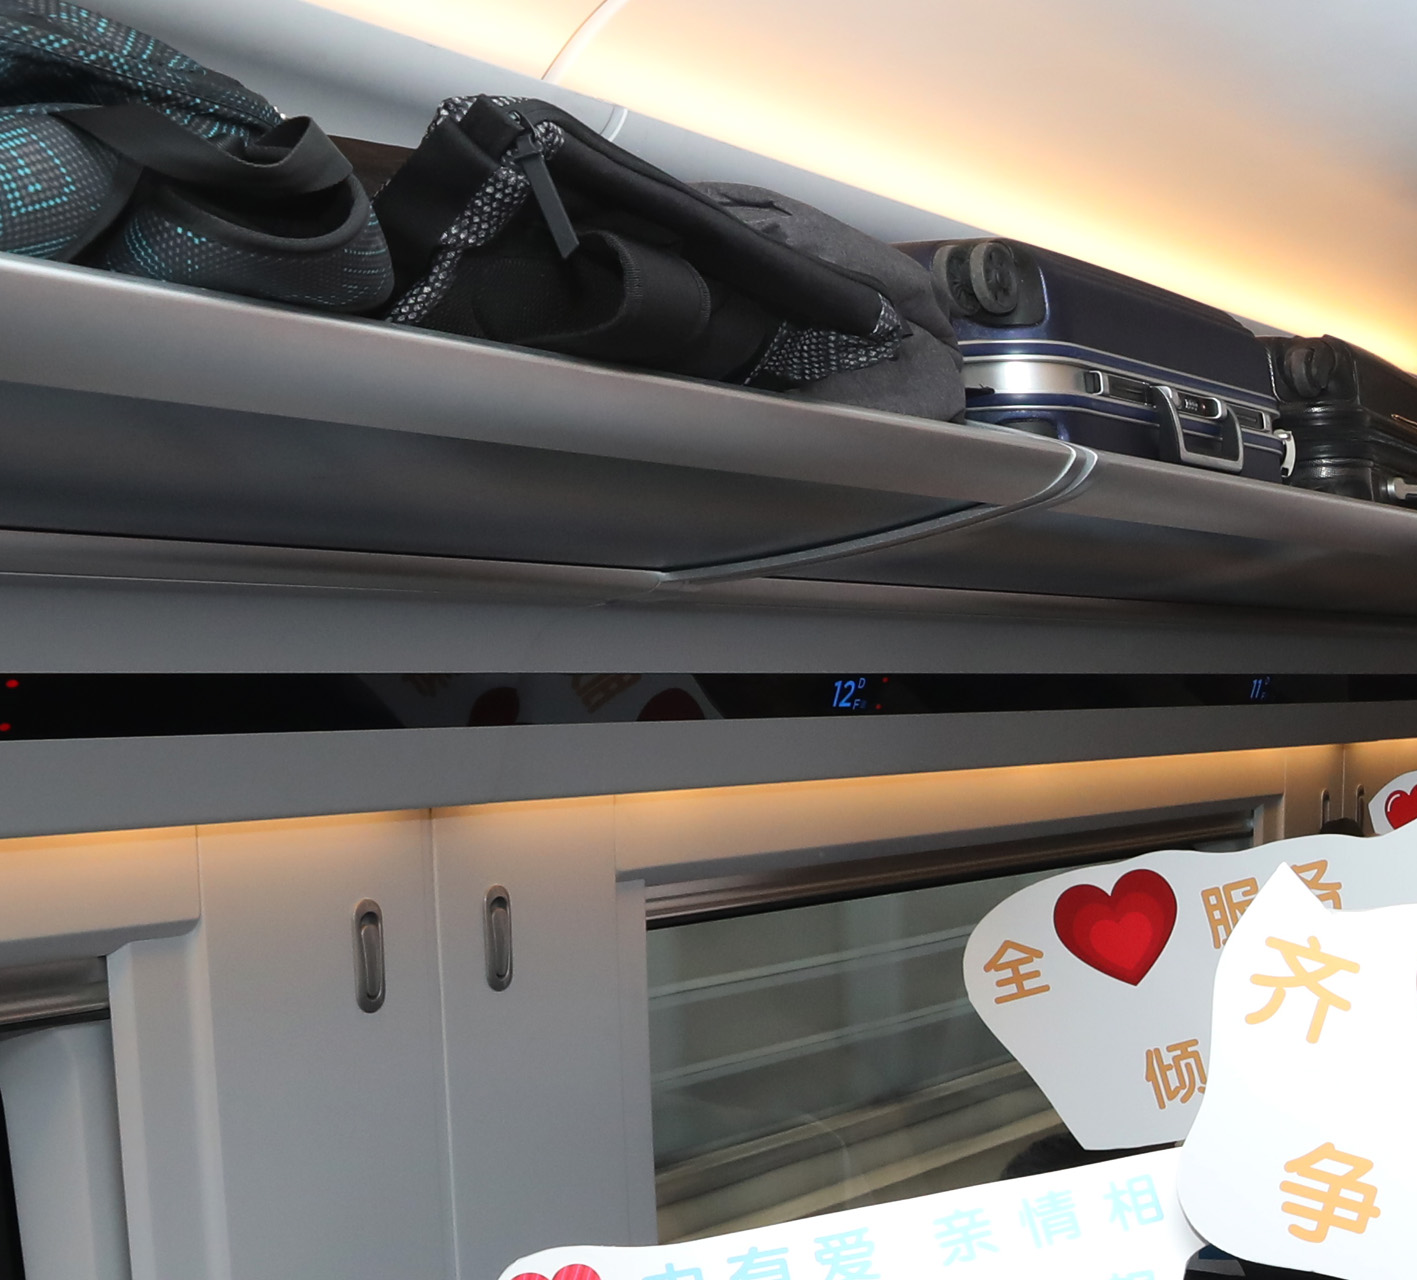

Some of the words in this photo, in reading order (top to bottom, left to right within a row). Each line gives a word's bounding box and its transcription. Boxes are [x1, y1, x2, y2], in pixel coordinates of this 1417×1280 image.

[833, 680, 856, 707] 12
[983, 939, 1051, 1005] 全
[1245, 935, 1361, 1044] 齐
[1145, 1039, 1206, 1110] 倾
[932, 1173, 1165, 1265] 亲情相
